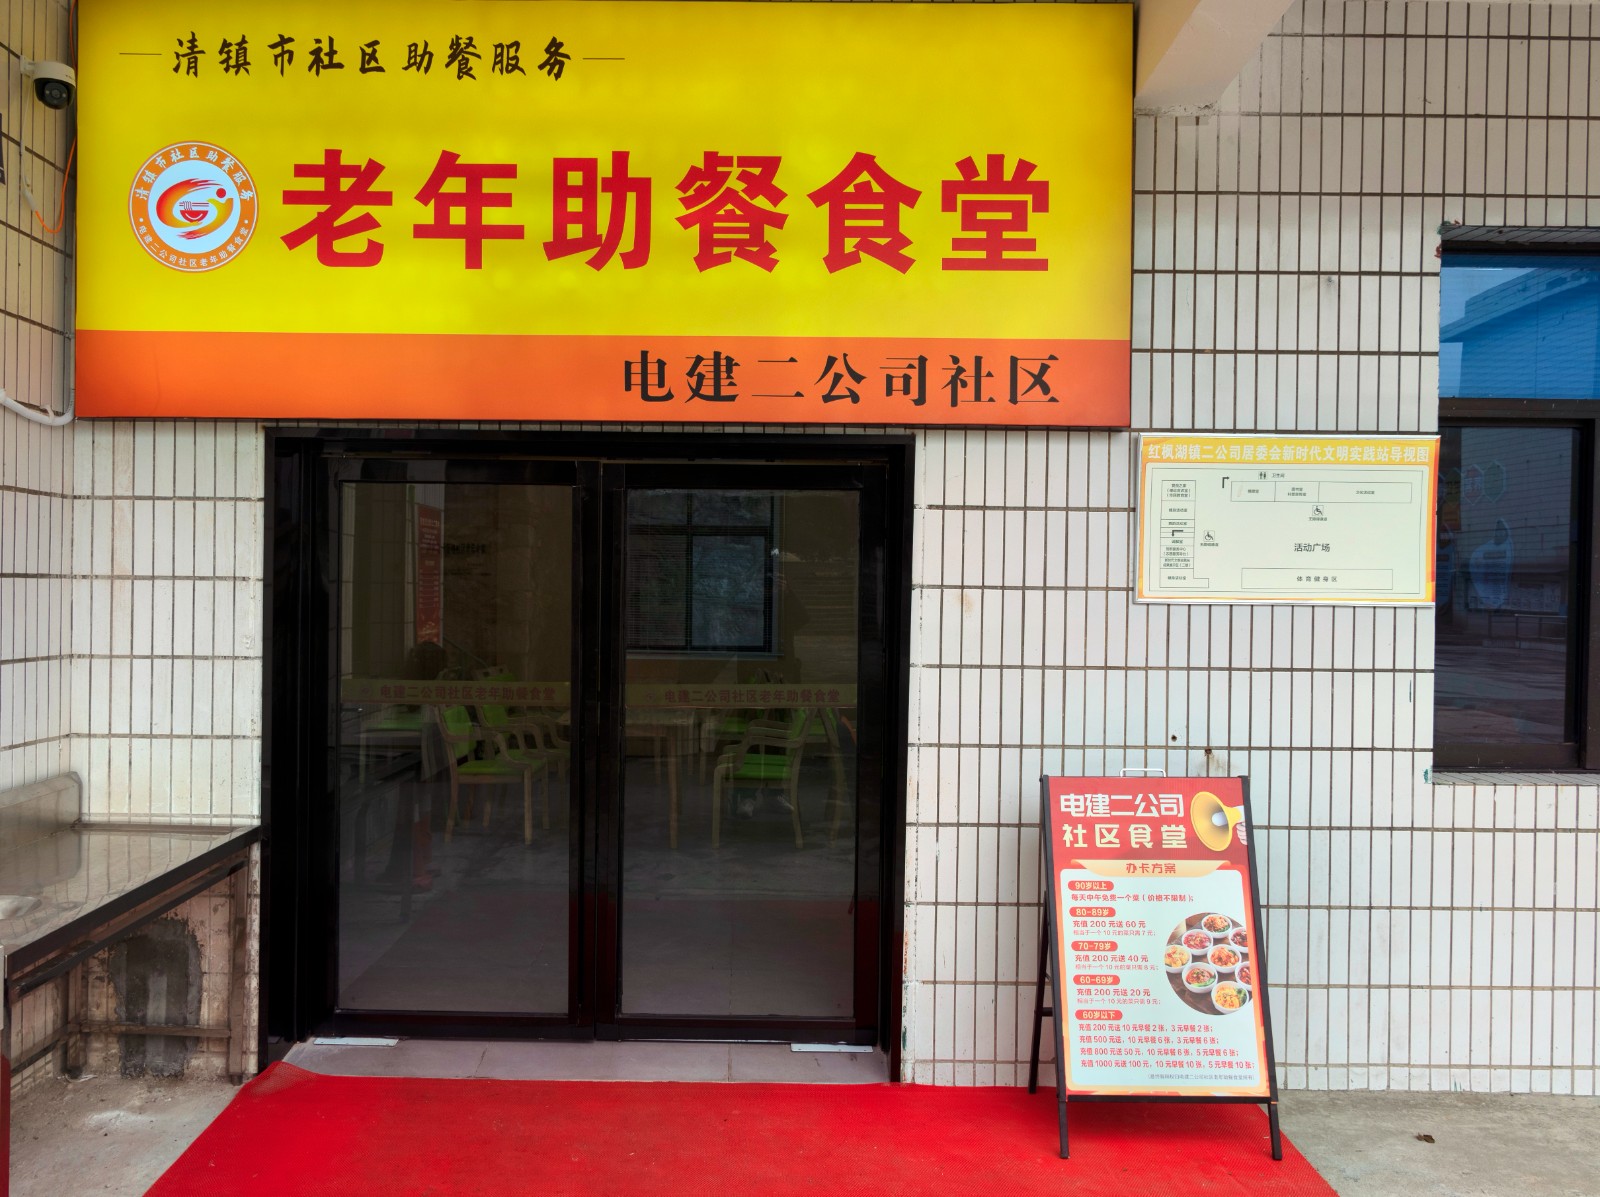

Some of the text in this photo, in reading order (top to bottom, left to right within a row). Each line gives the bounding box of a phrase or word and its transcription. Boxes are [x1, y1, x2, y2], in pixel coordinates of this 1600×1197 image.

[173, 31, 572, 81] 清镇市社区助餐服务
[280, 148, 1050, 275] 老年助餐食堂
[624, 350, 1060, 408] 电建二公司社区
[1147, 443, 1430, 463] 红枫湖镇二公司居委会新时代文明实践站导视图
[1293, 542, 1331, 553] 活动广场
[1060, 793, 1185, 818] 电建二公司
[1062, 823, 1188, 849] 社区食堂
[1125, 862, 1176, 874] 办卡方案
[1074, 881, 1108, 891] 90岁以上
[1075, 907, 1109, 917] 80-89岁
[1078, 941, 1111, 951] 70-79岁
[1079, 975, 1113, 985] 60-69岁
[1082, 1010, 1115, 1019] 60岁以下
